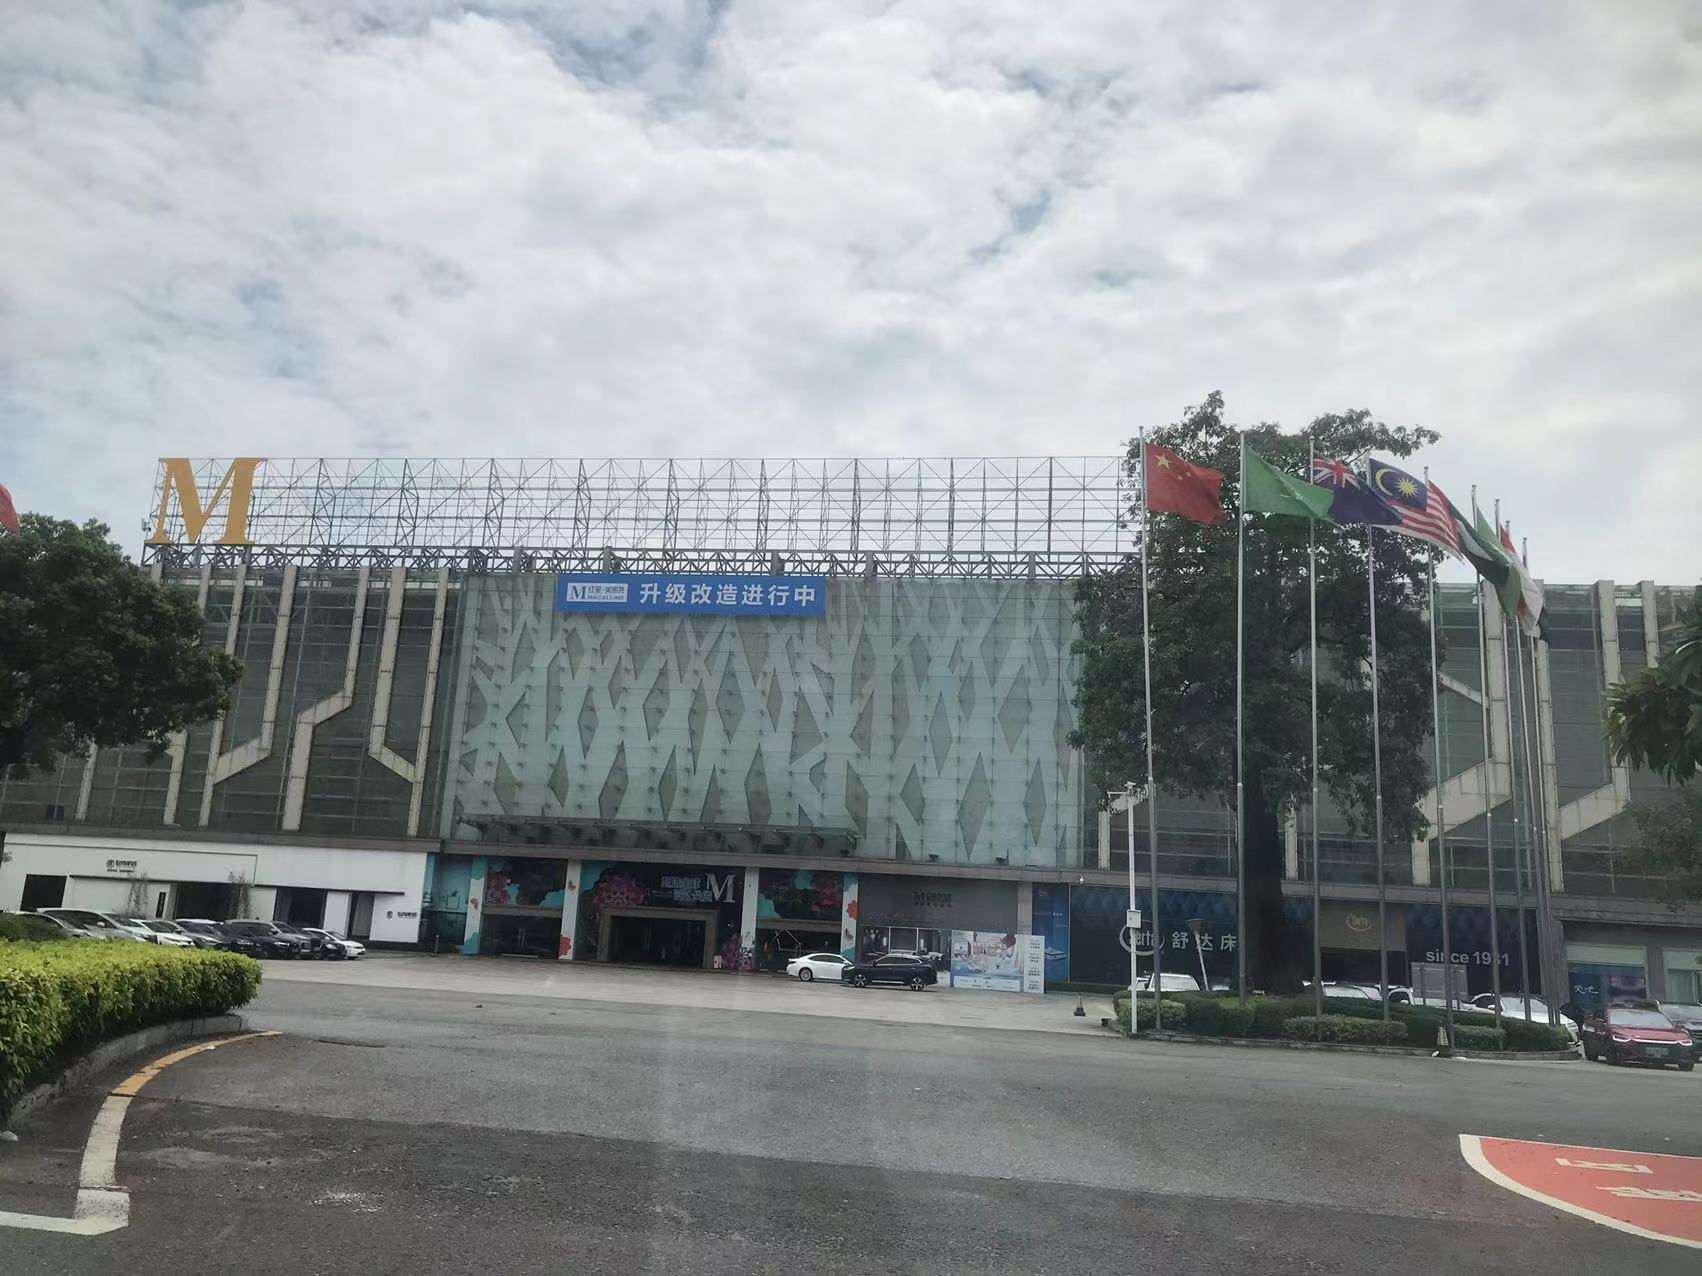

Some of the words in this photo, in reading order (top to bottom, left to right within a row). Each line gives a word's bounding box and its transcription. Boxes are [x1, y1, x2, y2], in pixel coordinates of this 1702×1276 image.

[145, 458, 264, 544] M
[570, 585, 587, 600] M
[639, 582, 815, 608] 升级改造进行中
[706, 873, 737, 904] M
[1129, 930, 1157, 947] ert
